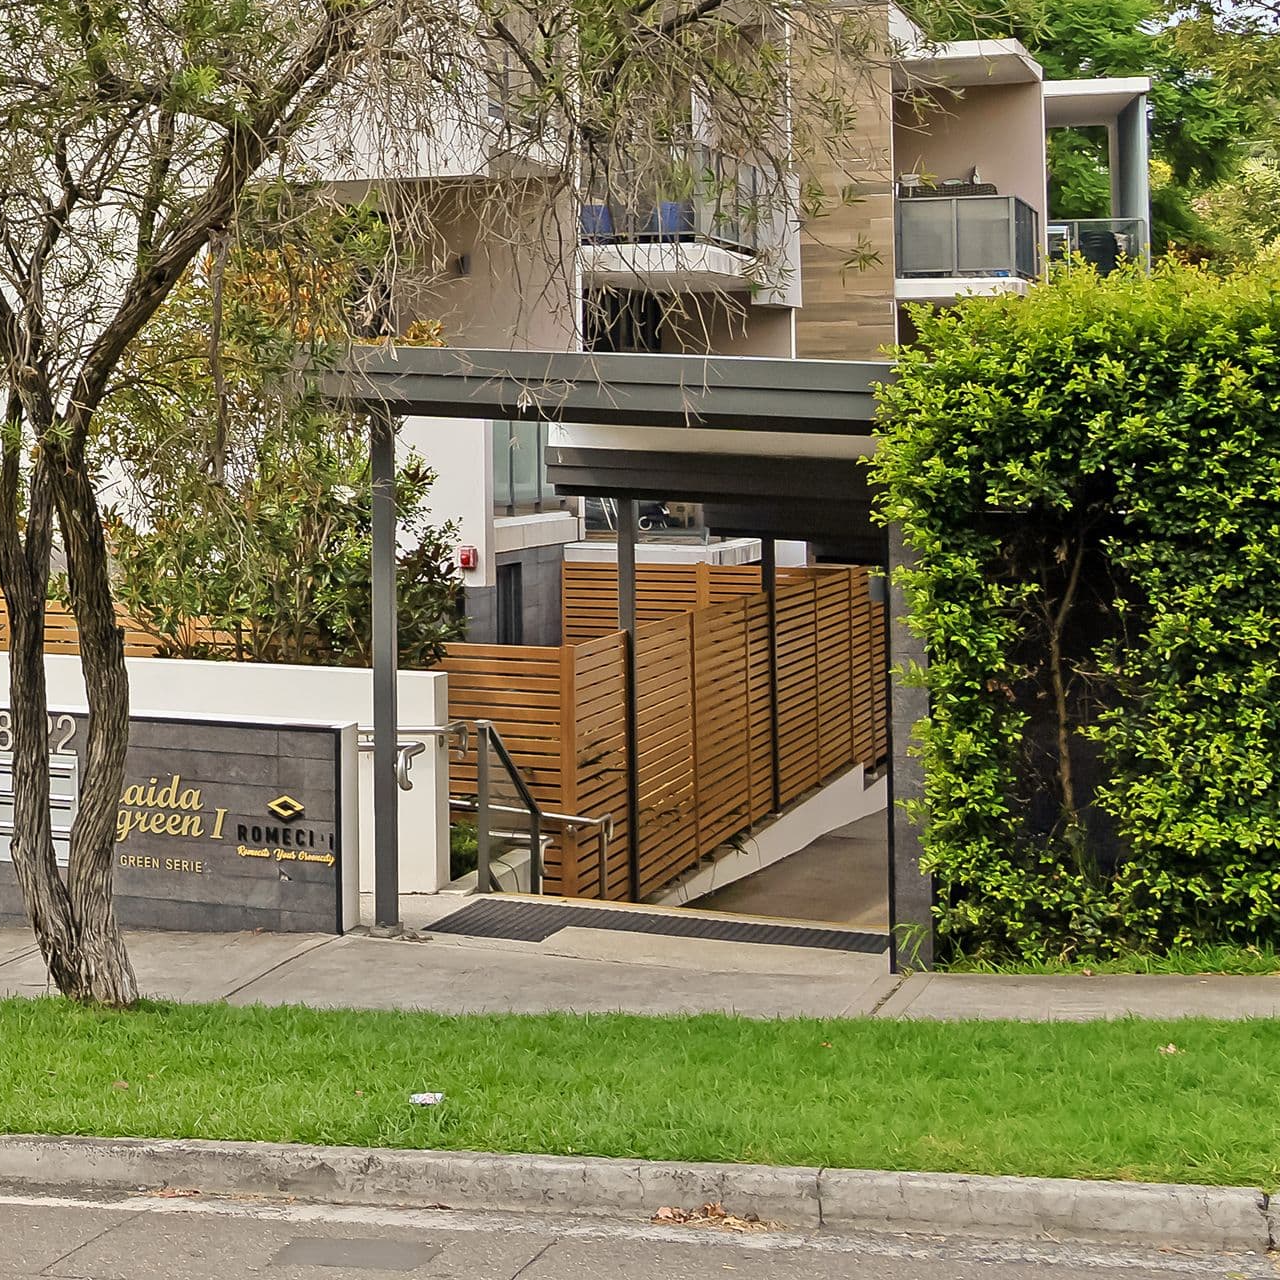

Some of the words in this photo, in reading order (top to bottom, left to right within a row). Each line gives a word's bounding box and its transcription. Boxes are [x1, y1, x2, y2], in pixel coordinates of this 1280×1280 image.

[119, 774, 204, 811] aida
[116, 809, 205, 842] green
[120, 854, 160, 869] GREEN
